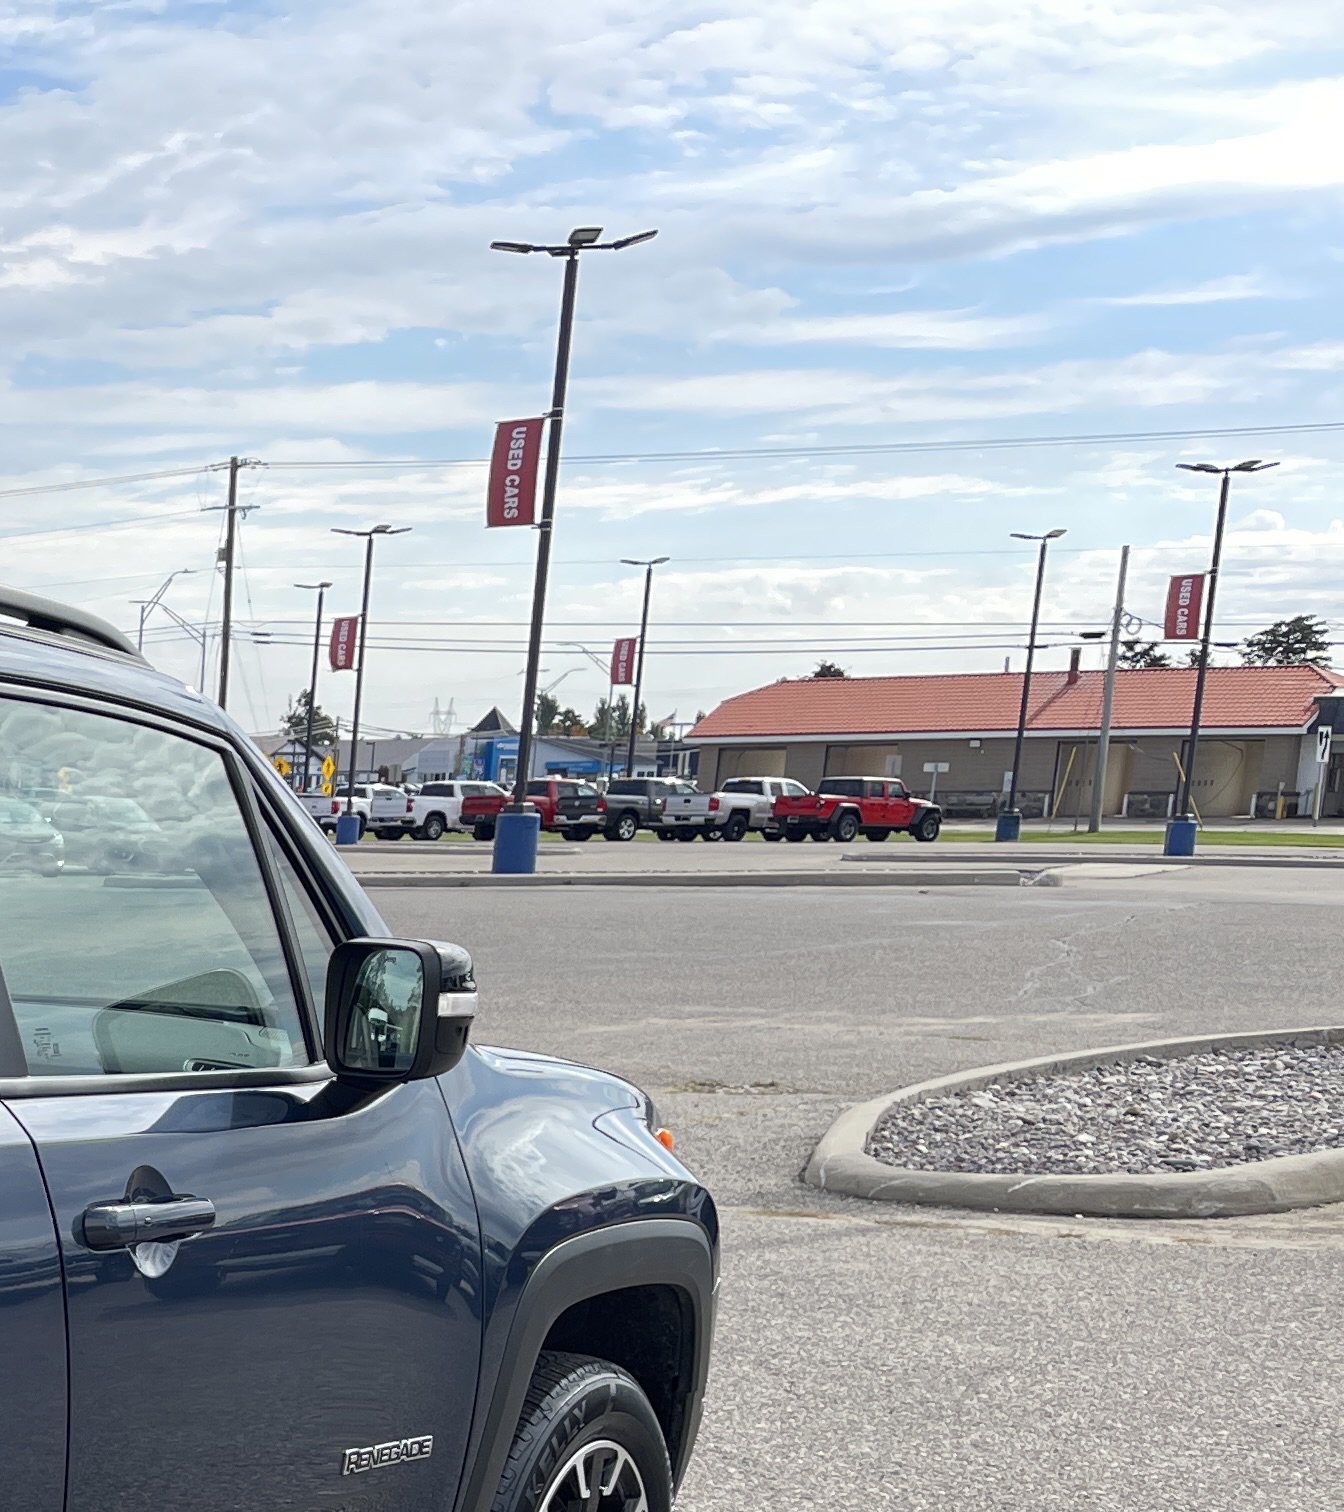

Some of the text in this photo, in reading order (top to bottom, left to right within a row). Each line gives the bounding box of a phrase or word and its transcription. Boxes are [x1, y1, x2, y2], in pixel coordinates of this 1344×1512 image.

[503, 426, 527, 519] USED CARS
[1176, 578, 1193, 635] USED CARS
[342, 1435, 433, 1475] RENEGADE
[524, 1399, 588, 1507] KELLY
